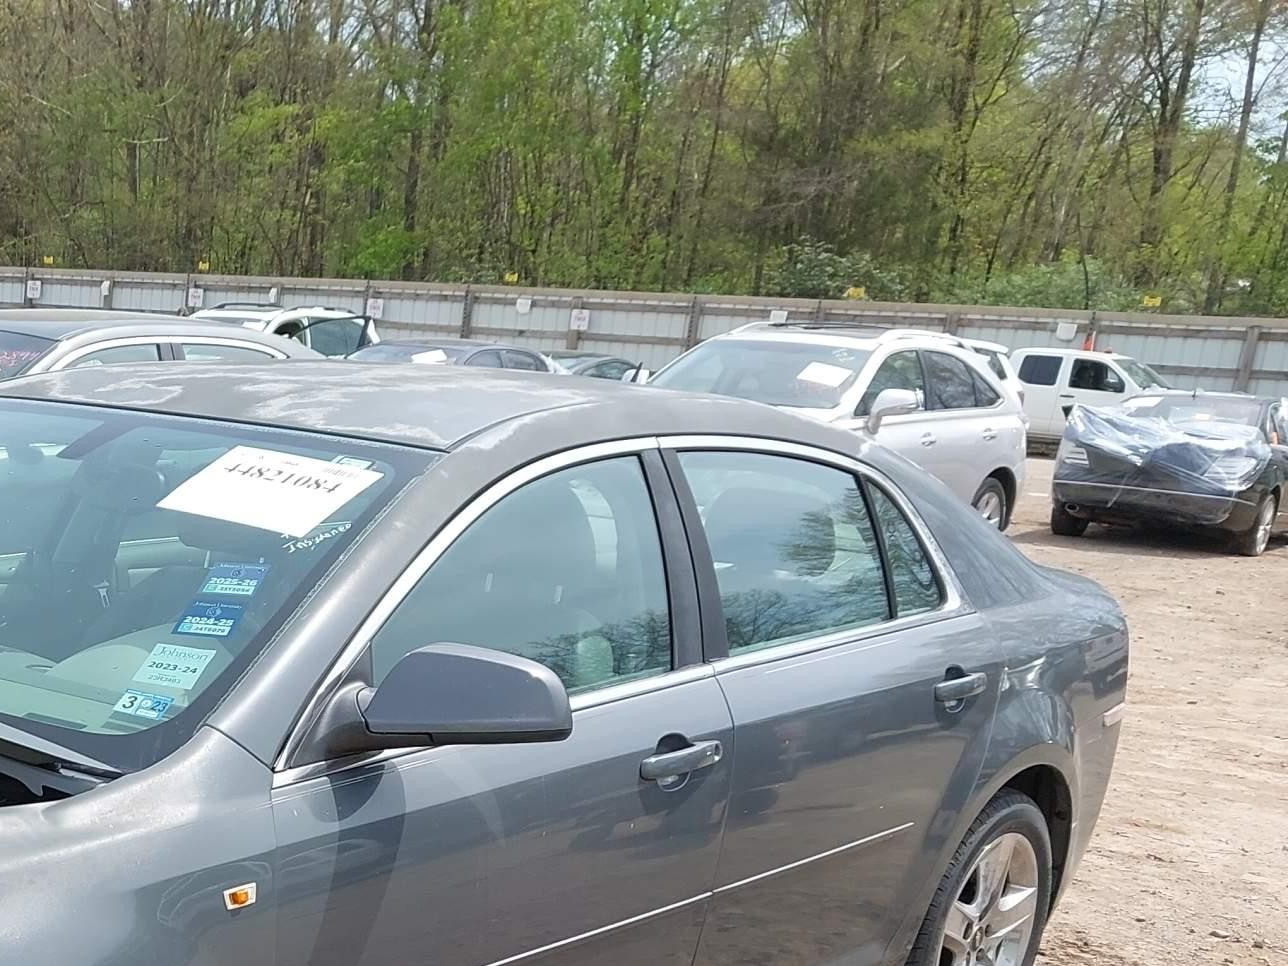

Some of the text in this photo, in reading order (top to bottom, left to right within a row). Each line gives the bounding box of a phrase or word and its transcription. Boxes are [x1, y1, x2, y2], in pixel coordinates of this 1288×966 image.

[223, 463, 343, 493] 44821084
[208, 577, 259, 587] 2025-26
[183, 615, 235, 626] 2024-25
[153, 646, 209, 662] Johnson
[147, 661, 199, 674] 2023-24
[121, 695, 169, 713] 3 23
